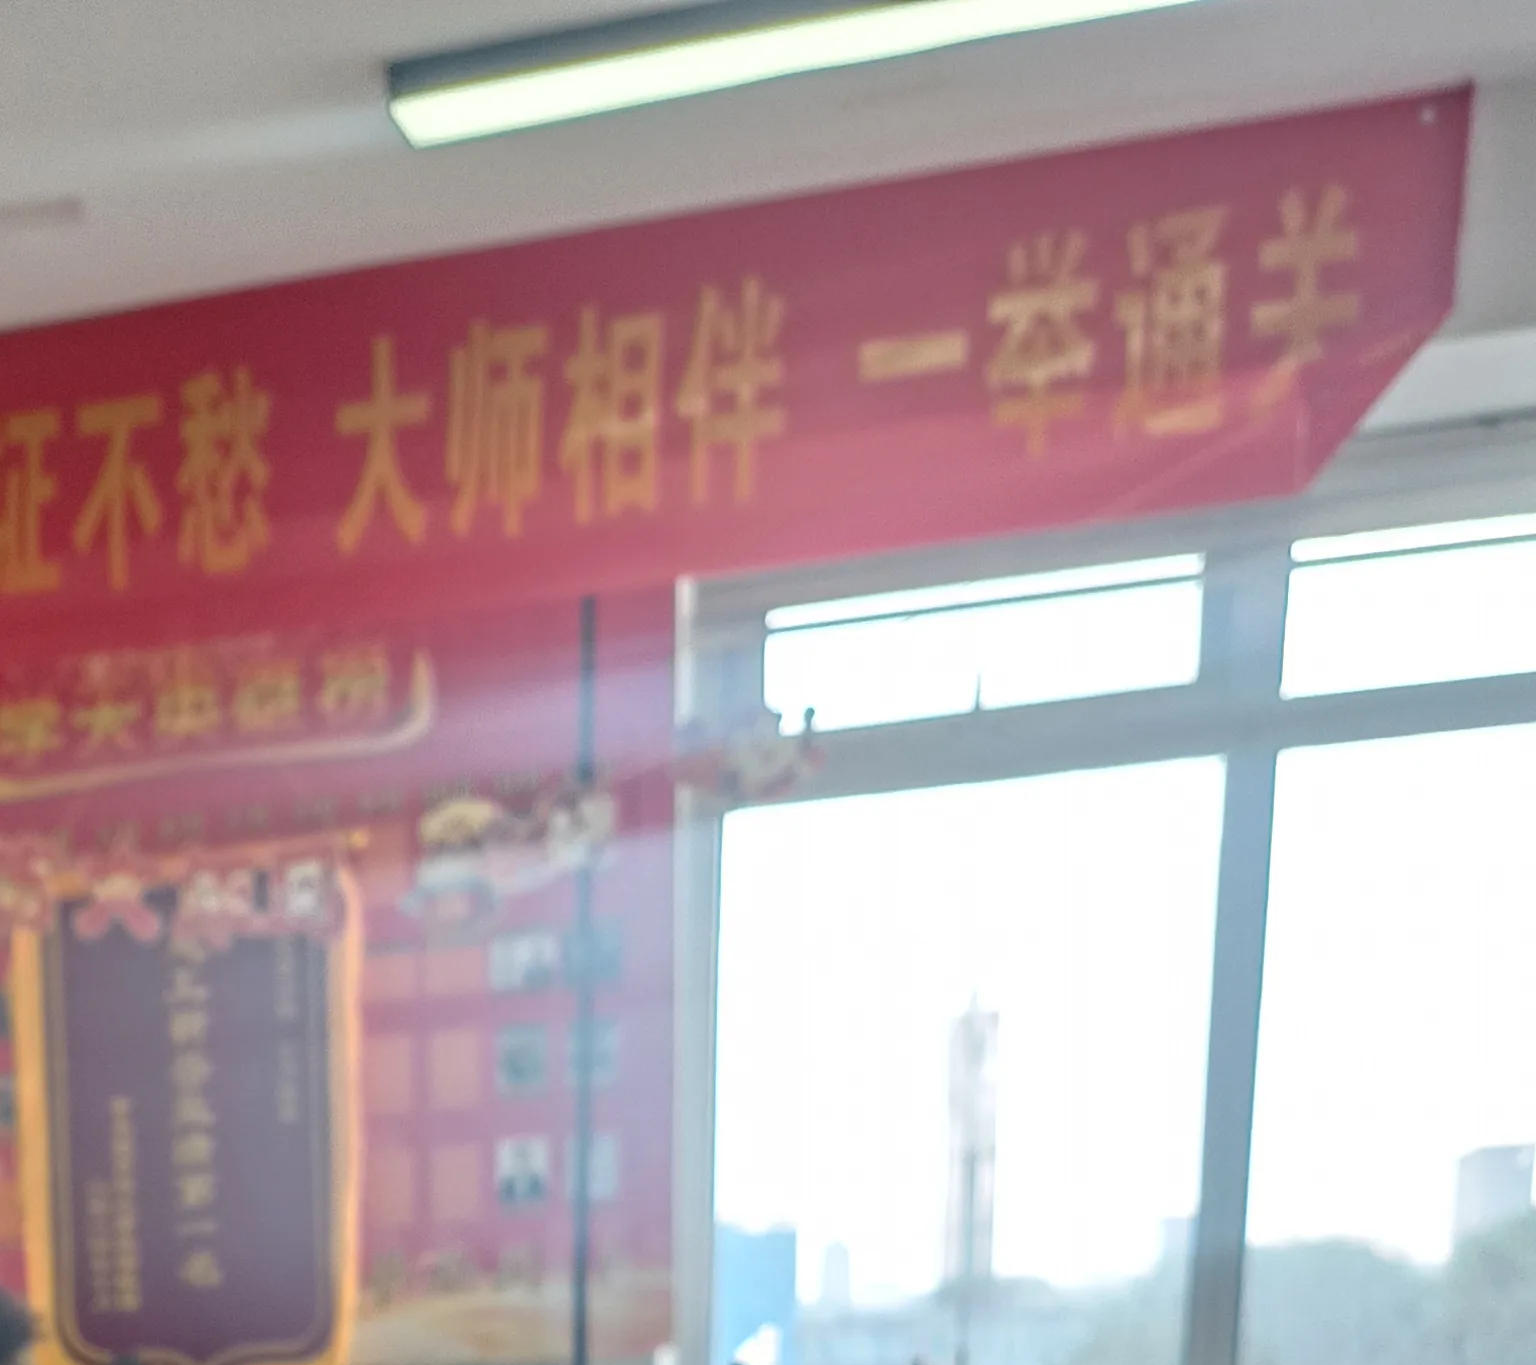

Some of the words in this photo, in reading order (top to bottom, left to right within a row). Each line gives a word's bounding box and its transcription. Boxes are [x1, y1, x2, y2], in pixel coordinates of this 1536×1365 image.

[336, 277, 787, 556] 大师相伴
[858, 184, 1363, 458] 一举通关
